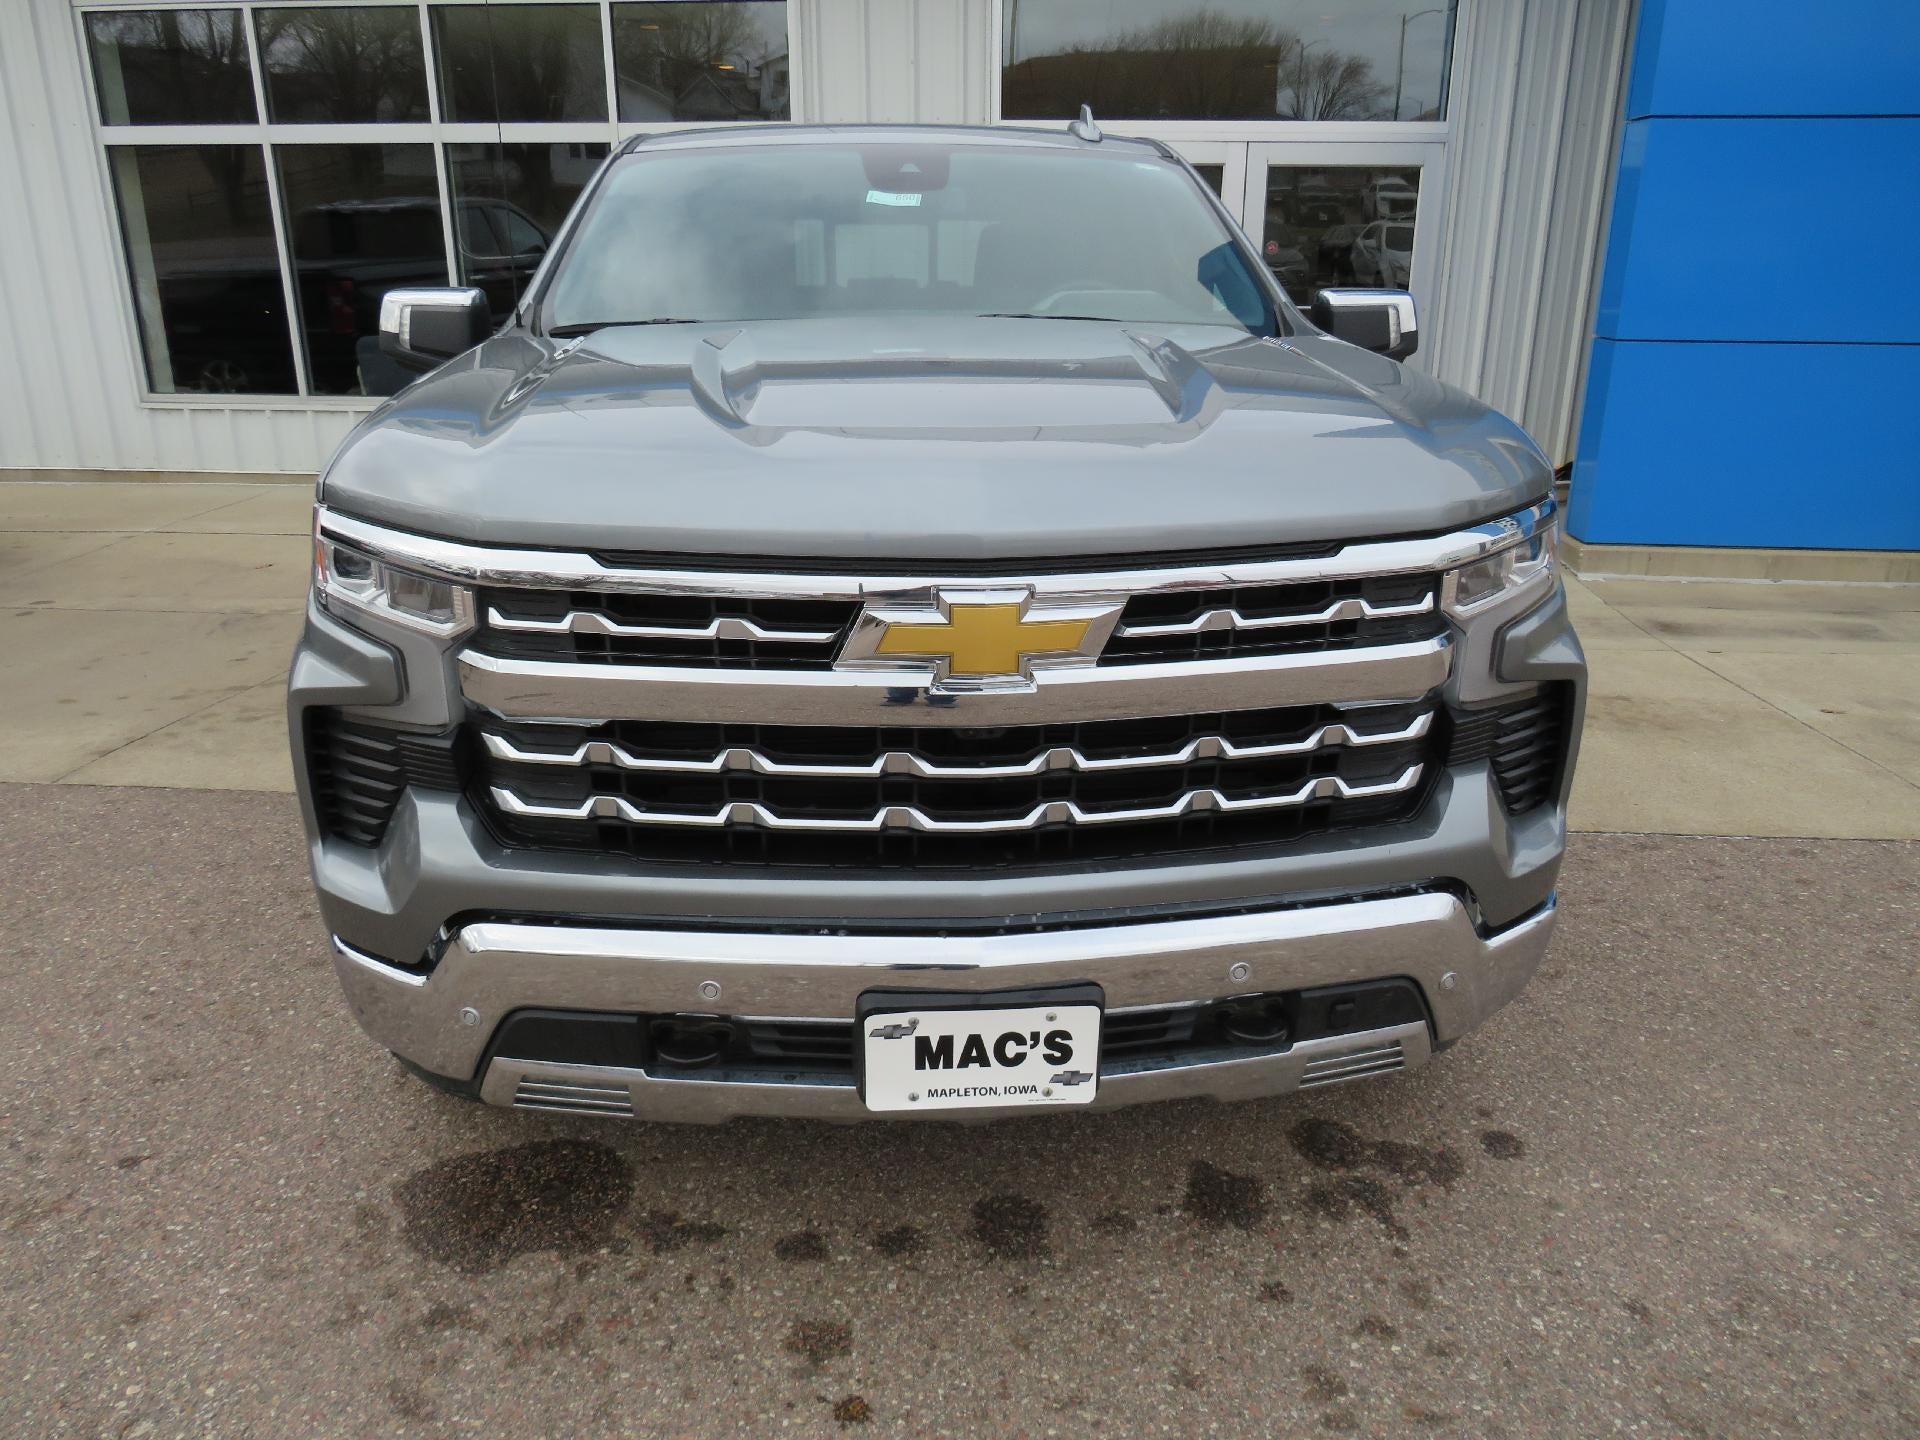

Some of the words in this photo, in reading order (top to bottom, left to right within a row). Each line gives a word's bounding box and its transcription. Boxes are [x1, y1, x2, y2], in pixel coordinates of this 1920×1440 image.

[914, 1029, 1074, 1071] MAC'S
[927, 1086, 1001, 1098] MAPLETON,
[1003, 1084, 1038, 1095] IOWA
